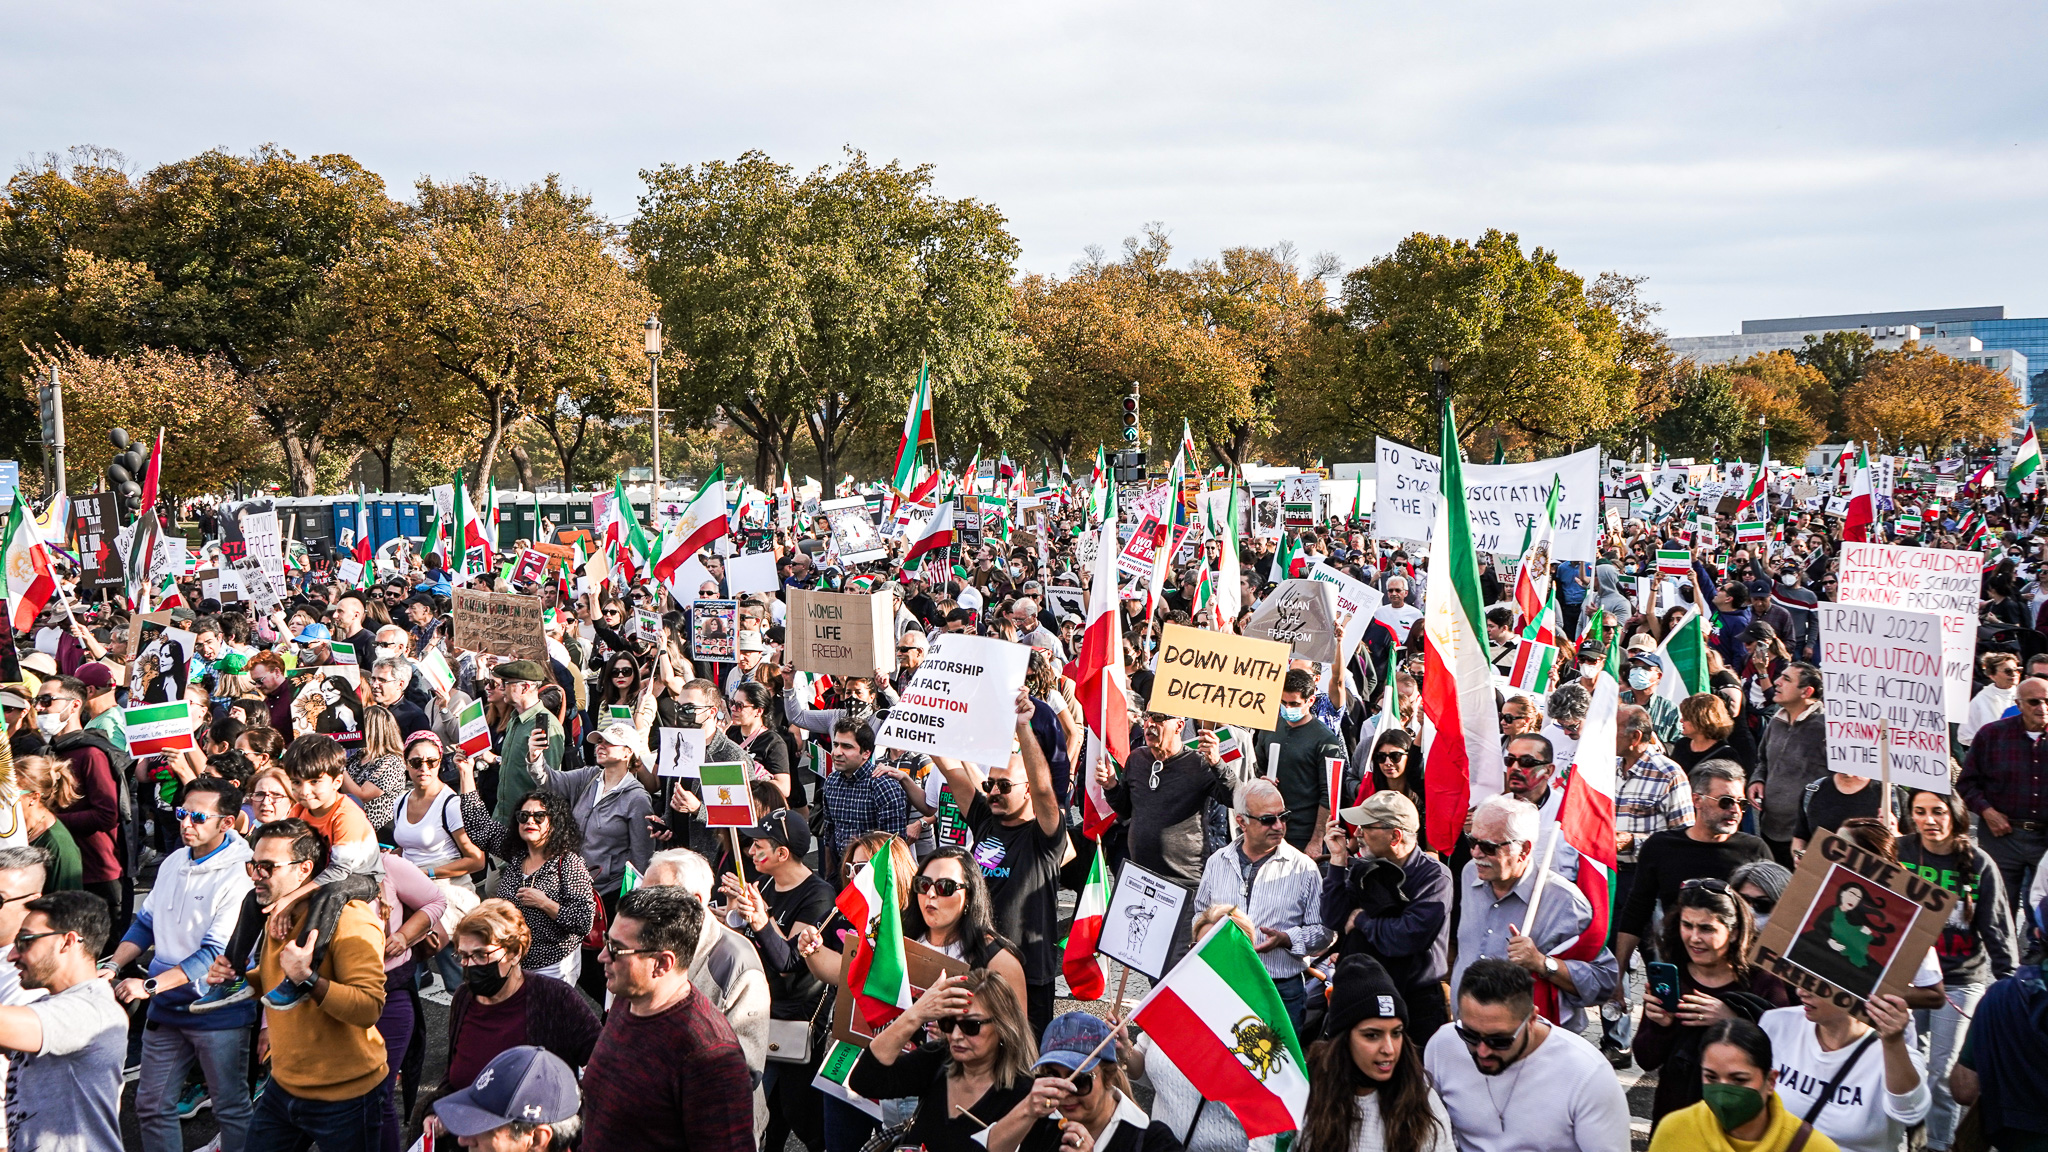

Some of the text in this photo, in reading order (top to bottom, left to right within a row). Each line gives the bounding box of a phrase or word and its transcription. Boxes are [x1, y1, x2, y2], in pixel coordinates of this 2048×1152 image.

[1382, 448, 1441, 473] TO DEM
[1397, 474, 1430, 492] STOP
[74, 498, 101, 517] THERE IS
[1390, 498, 1421, 514] THE
[222, 541, 246, 555] STA
[248, 534, 275, 559] FREE
[1130, 544, 1143, 555] OF
[1127, 563, 1142, 573] THEIR
[1846, 548, 1983, 573] KILLING CHILDREN
[1841, 570, 1980, 593] ATTACKING SCHOOLS
[458, 595, 487, 613] IRANIAN
[489, 603, 520, 617] WOMEN
[1275, 599, 1310, 611] WOMAN
[1348, 587, 1374, 609] LIFE
[1841, 588, 1901, 605] BURNING
[808, 603, 842, 619] WOMEN
[816, 625, 841, 640] LIFE
[1267, 628, 1312, 642] FREEDOM
[1824, 609, 1929, 643] IRAN 2022
[811, 643, 853, 659] FREEDOM
[1825, 642, 1942, 677] REVOLUTION
[919, 659, 984, 677] CTATORSHIP
[1164, 645, 1281, 682] DOWN WITH
[920, 678, 951, 695] FACT,
[1168, 678, 1265, 714] DICTATOR
[1824, 672, 1943, 705] TAKE ACTION
[889, 709, 945, 728] BECOMES
[1827, 699, 1946, 732] TO END 44 YEARS
[164, 727, 190, 736] Freedom
[884, 725, 936, 744] A RIGHT.
[1827, 721, 1882, 746] TYRANNY
[1888, 727, 1946, 754] TERROR
[1831, 745, 1947, 777] IN THE WORLD
[1821, 836, 1949, 912] GIVE US
[1157, 892, 1175, 905] Freedom
[830, 1046, 852, 1076] WOMEN
[1779, 1063, 1863, 1106] NAUTCA
